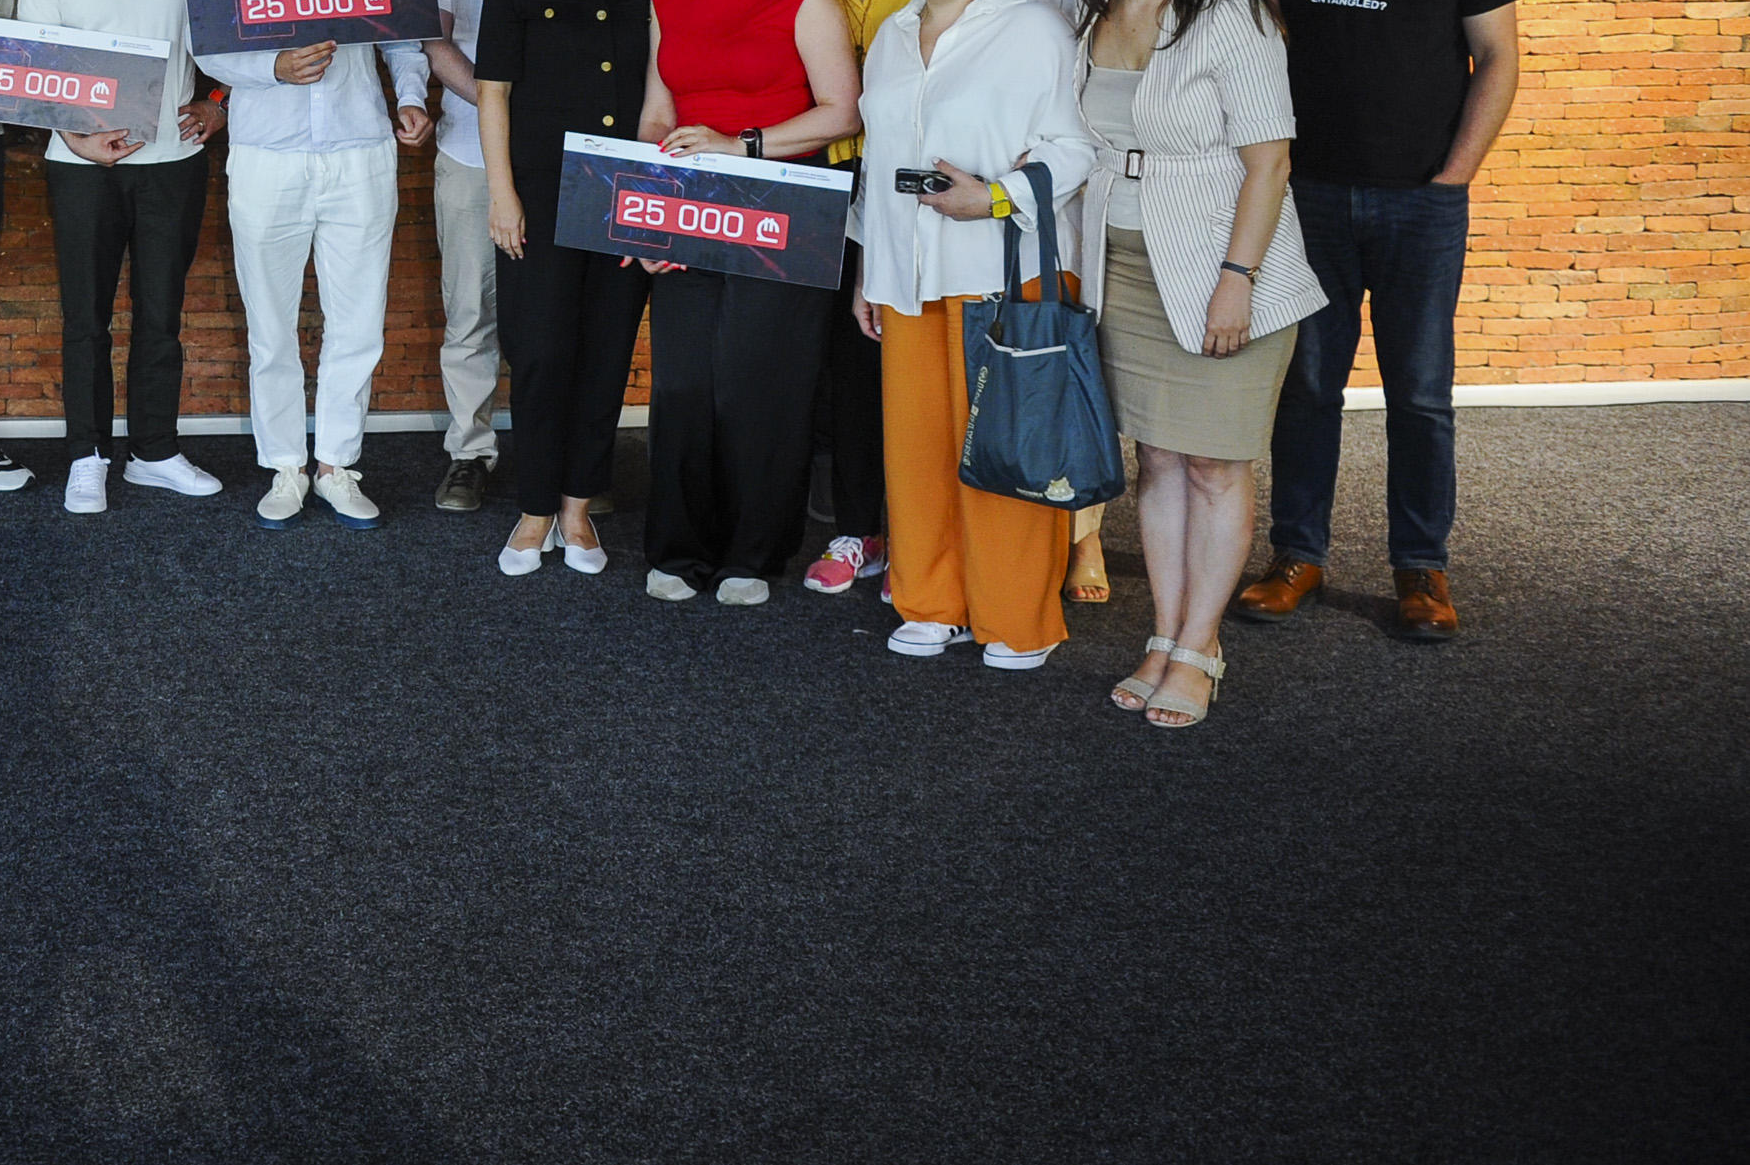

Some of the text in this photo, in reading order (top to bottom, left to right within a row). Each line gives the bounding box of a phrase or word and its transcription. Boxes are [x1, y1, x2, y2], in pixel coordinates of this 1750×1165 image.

[25, 72, 80, 100] 000
[622, 196, 665, 226] 25
[678, 205, 744, 238] 000
